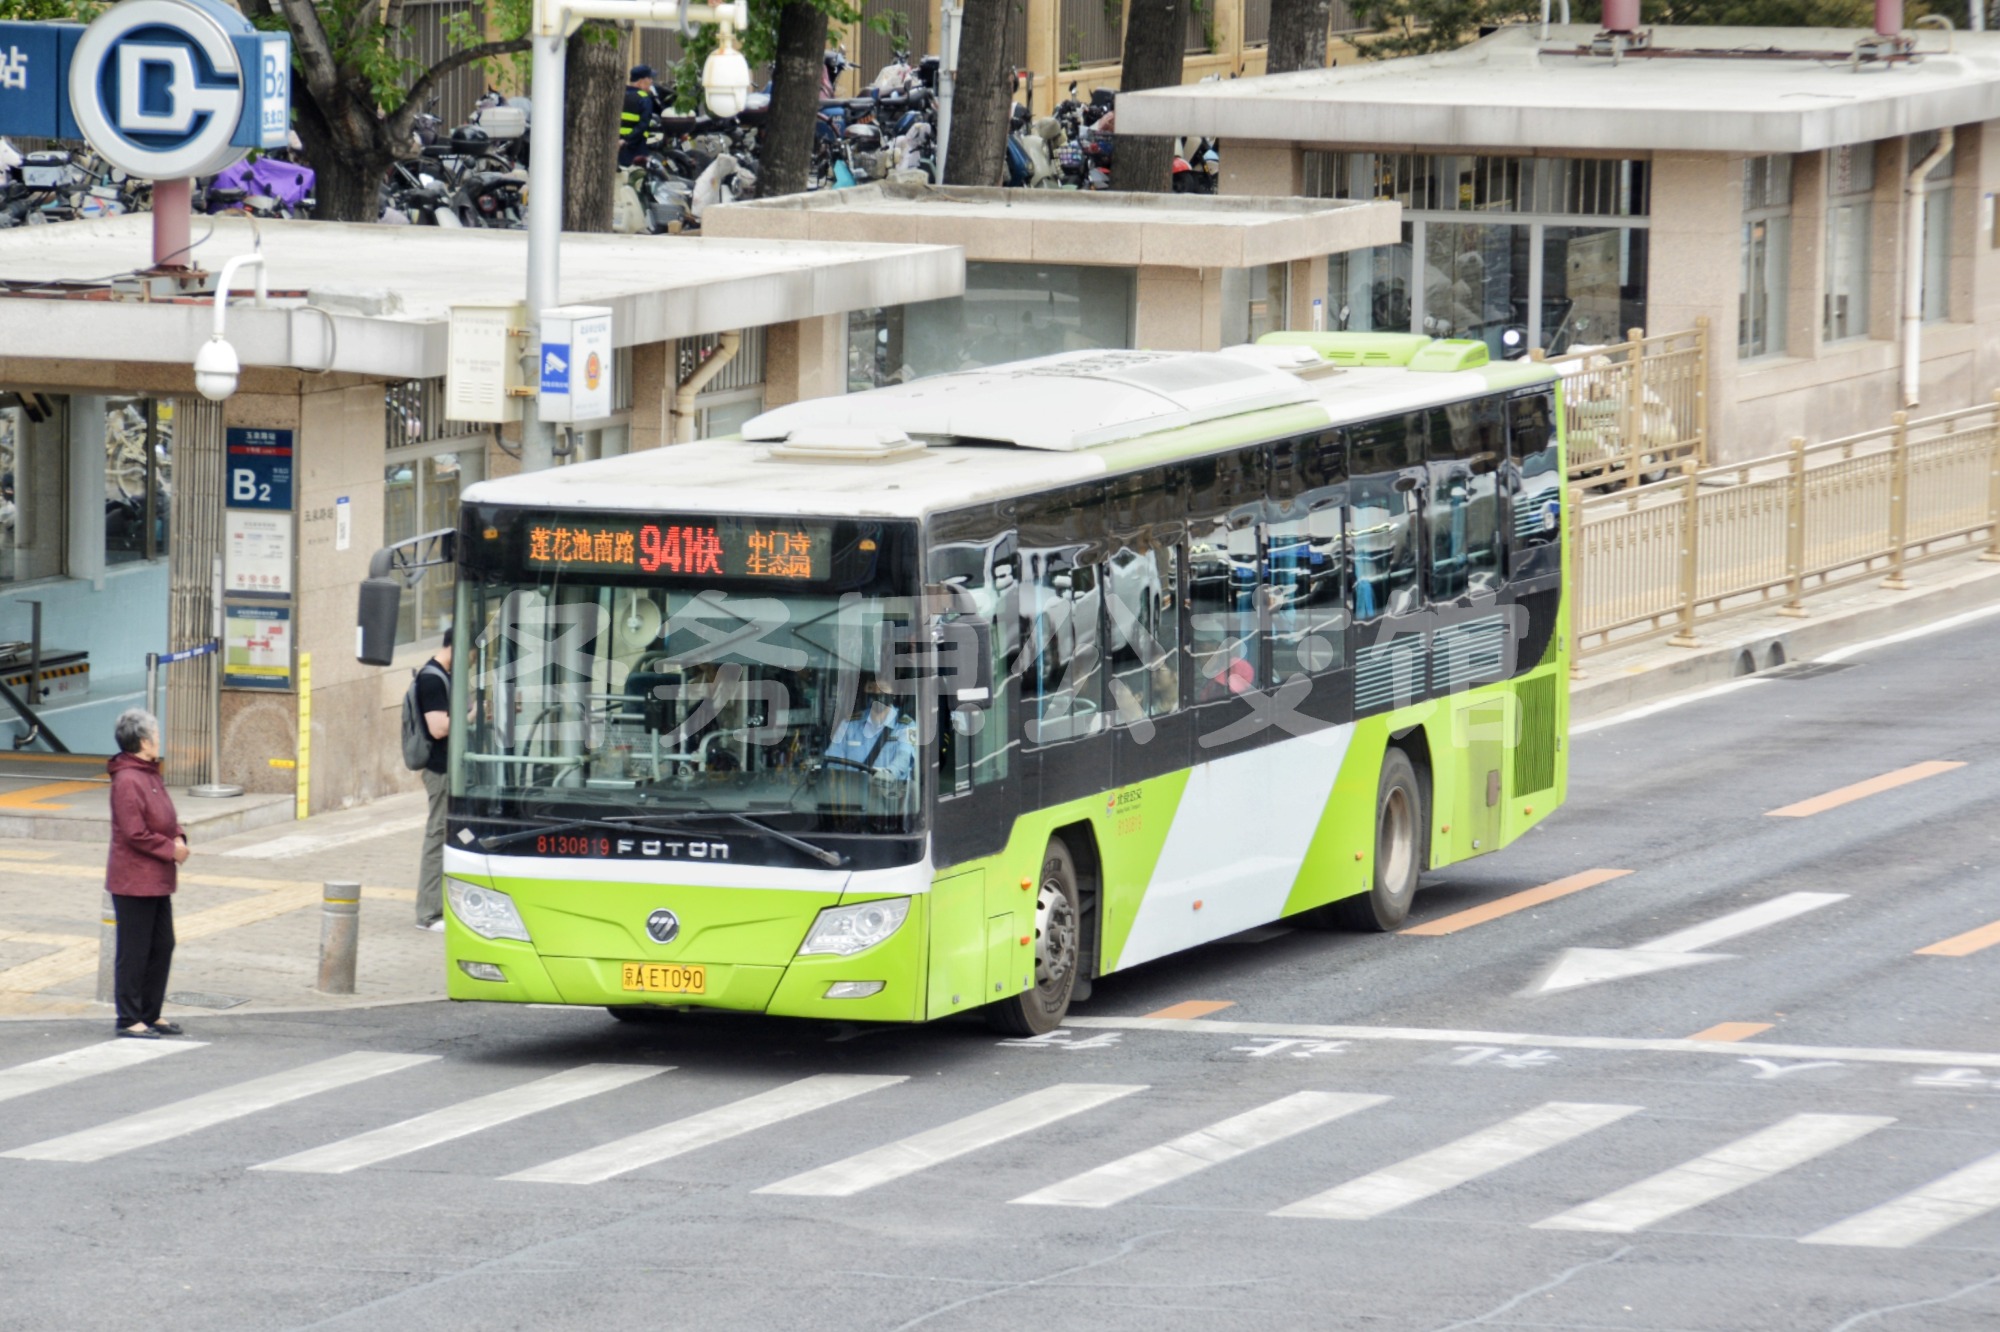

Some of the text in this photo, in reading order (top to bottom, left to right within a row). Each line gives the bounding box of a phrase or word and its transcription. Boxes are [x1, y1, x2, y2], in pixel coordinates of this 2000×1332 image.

[264, 55, 284, 98] B2
[233, 468, 271, 502] B2
[529, 524, 724, 575] 莲花池南路 941快
[748, 531, 811, 555] 中门寺
[746, 553, 811, 578] 生态园
[537, 834, 729, 859] 8130819 FOTON
